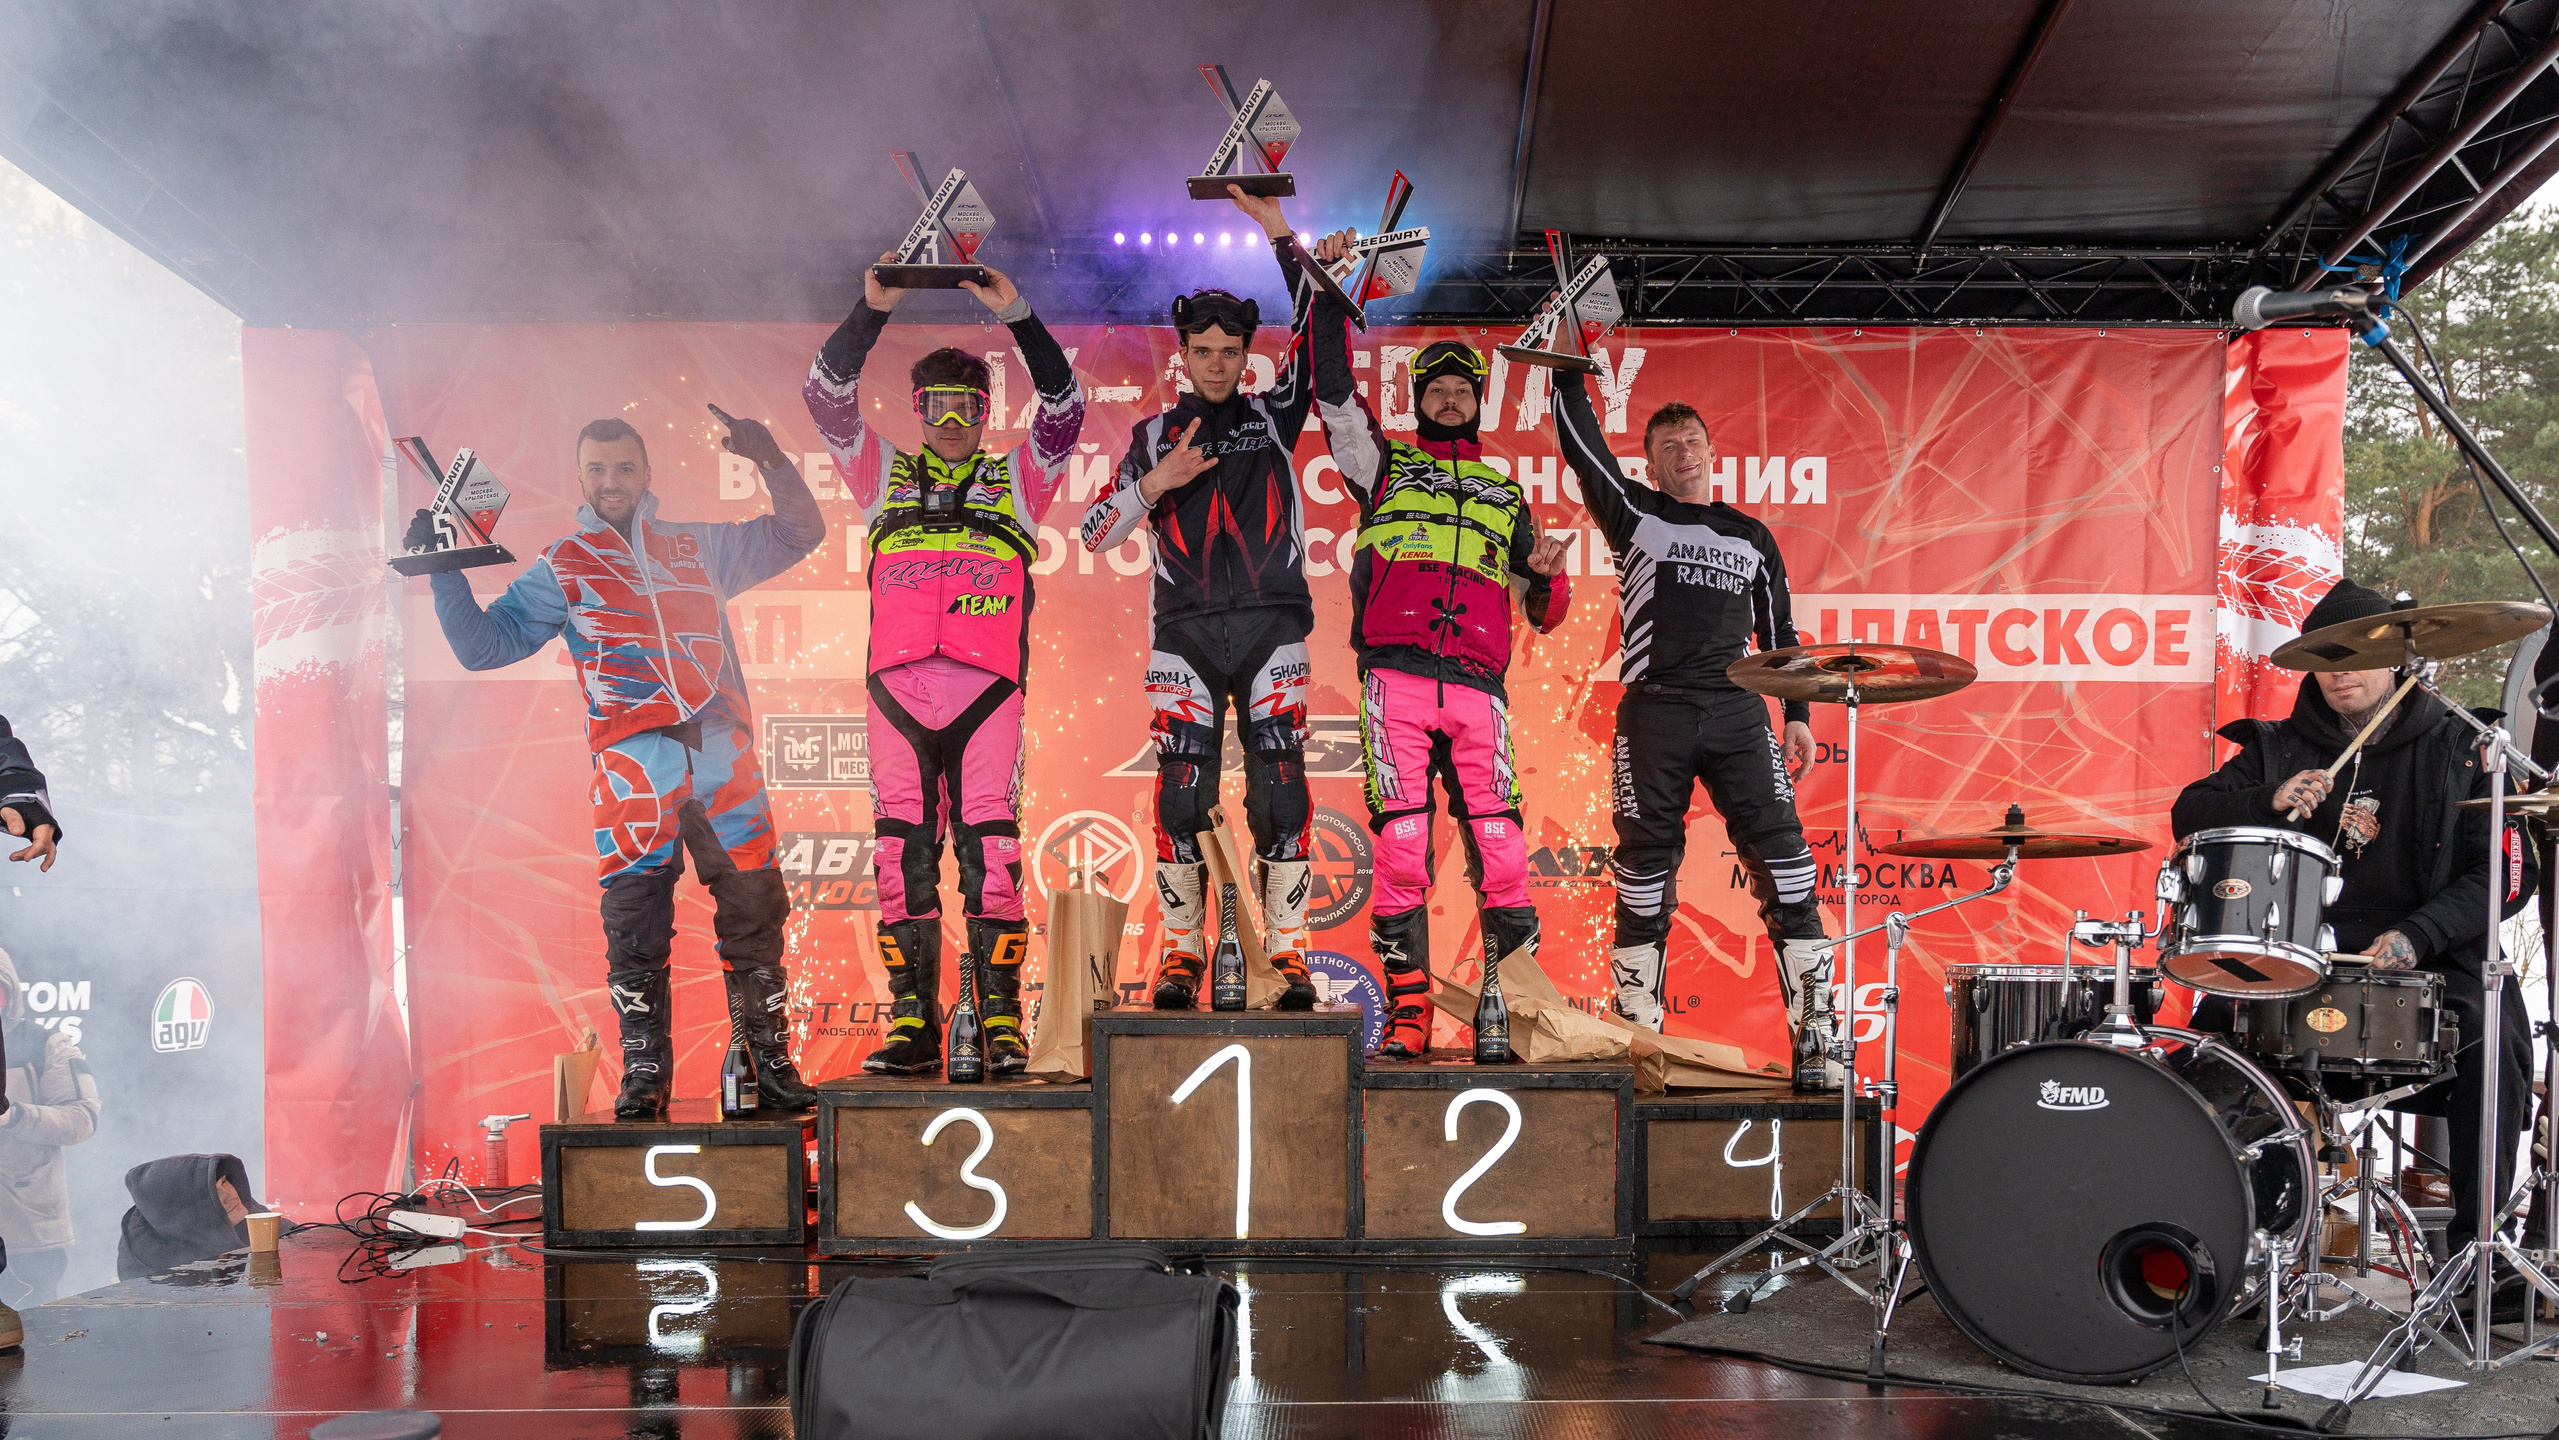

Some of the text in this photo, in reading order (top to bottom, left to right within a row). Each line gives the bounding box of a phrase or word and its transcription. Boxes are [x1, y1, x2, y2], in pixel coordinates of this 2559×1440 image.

[1205, 84, 1264, 176] MX-SPEEDWAY
[665, 532, 700, 560] 15
[1086, 508, 1120, 551] MOTORS
[670, 560, 696, 569] IVANOV
[1400, 551, 1433, 559] KENDA
[1418, 562, 1440, 573] BSE
[1667, 541, 1753, 576] ANARCHY
[878, 558, 1012, 595] Racing
[1677, 564, 1745, 595] RACING
[956, 594, 1008, 616] TEAM
[1155, 684, 1190, 696] MOTORS
[1616, 735, 1641, 819] ANARCHY
[1394, 819, 1417, 835] BSE
[1485, 822, 1505, 834] BSE
[780, 840, 876, 875] АВТ
[2511, 833, 2520, 892] DICKIES DICKIES
[1307, 956, 1357, 975] ЛЕТНОГО
[1359, 975, 1382, 1017] СПОРТА
[160, 1021, 205, 1050] agv
[817, 1028, 878, 1036] MOSCOW
[2059, 1087, 2105, 1105] FMD
[1168, 1044, 1251, 1239] 1
[904, 1107, 1007, 1239] 3
[1442, 1088, 1527, 1235] 2
[1724, 1118, 1782, 1220] 4
[635, 1144, 717, 1231] 5
